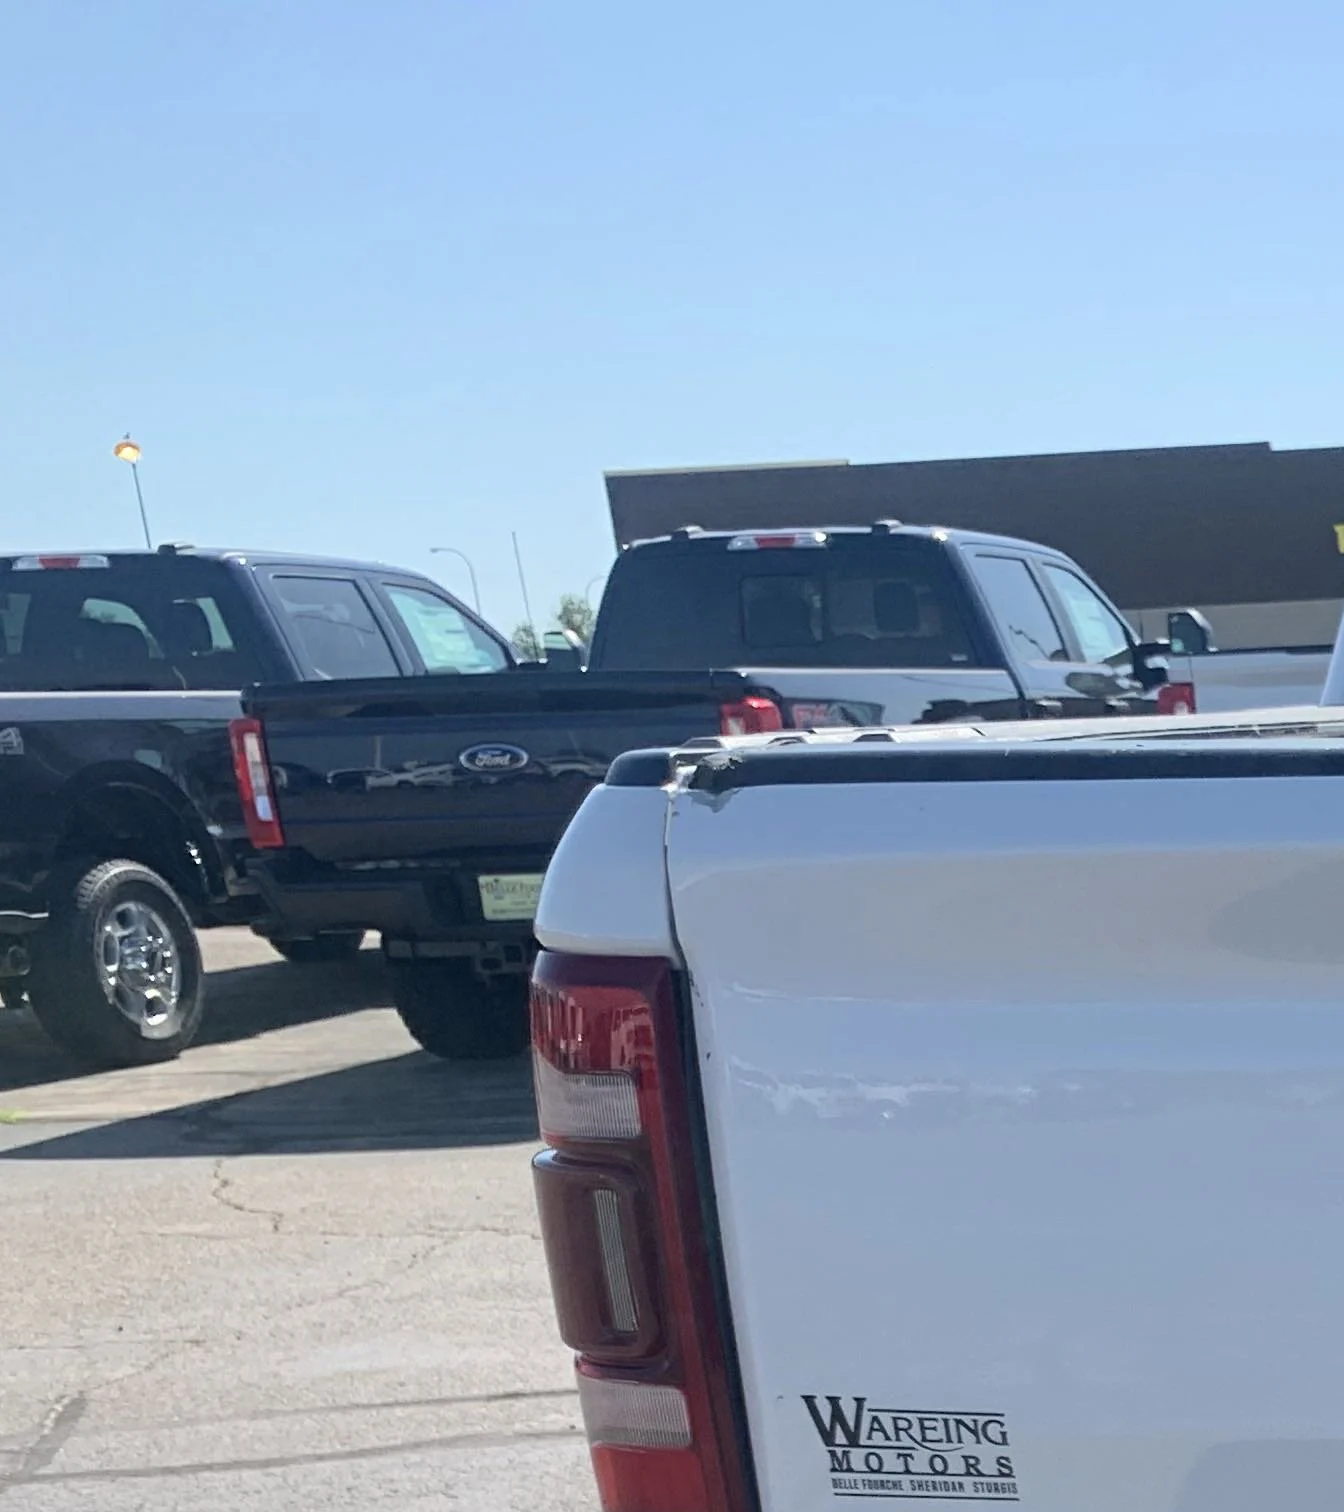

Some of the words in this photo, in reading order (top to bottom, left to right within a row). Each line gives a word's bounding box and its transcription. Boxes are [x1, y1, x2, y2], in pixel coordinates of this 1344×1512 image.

[829, 1450, 1015, 1477] MOTORS
[910, 1481, 965, 1493] SHERIDAN
[973, 1482, 1018, 1494] STURGIS
